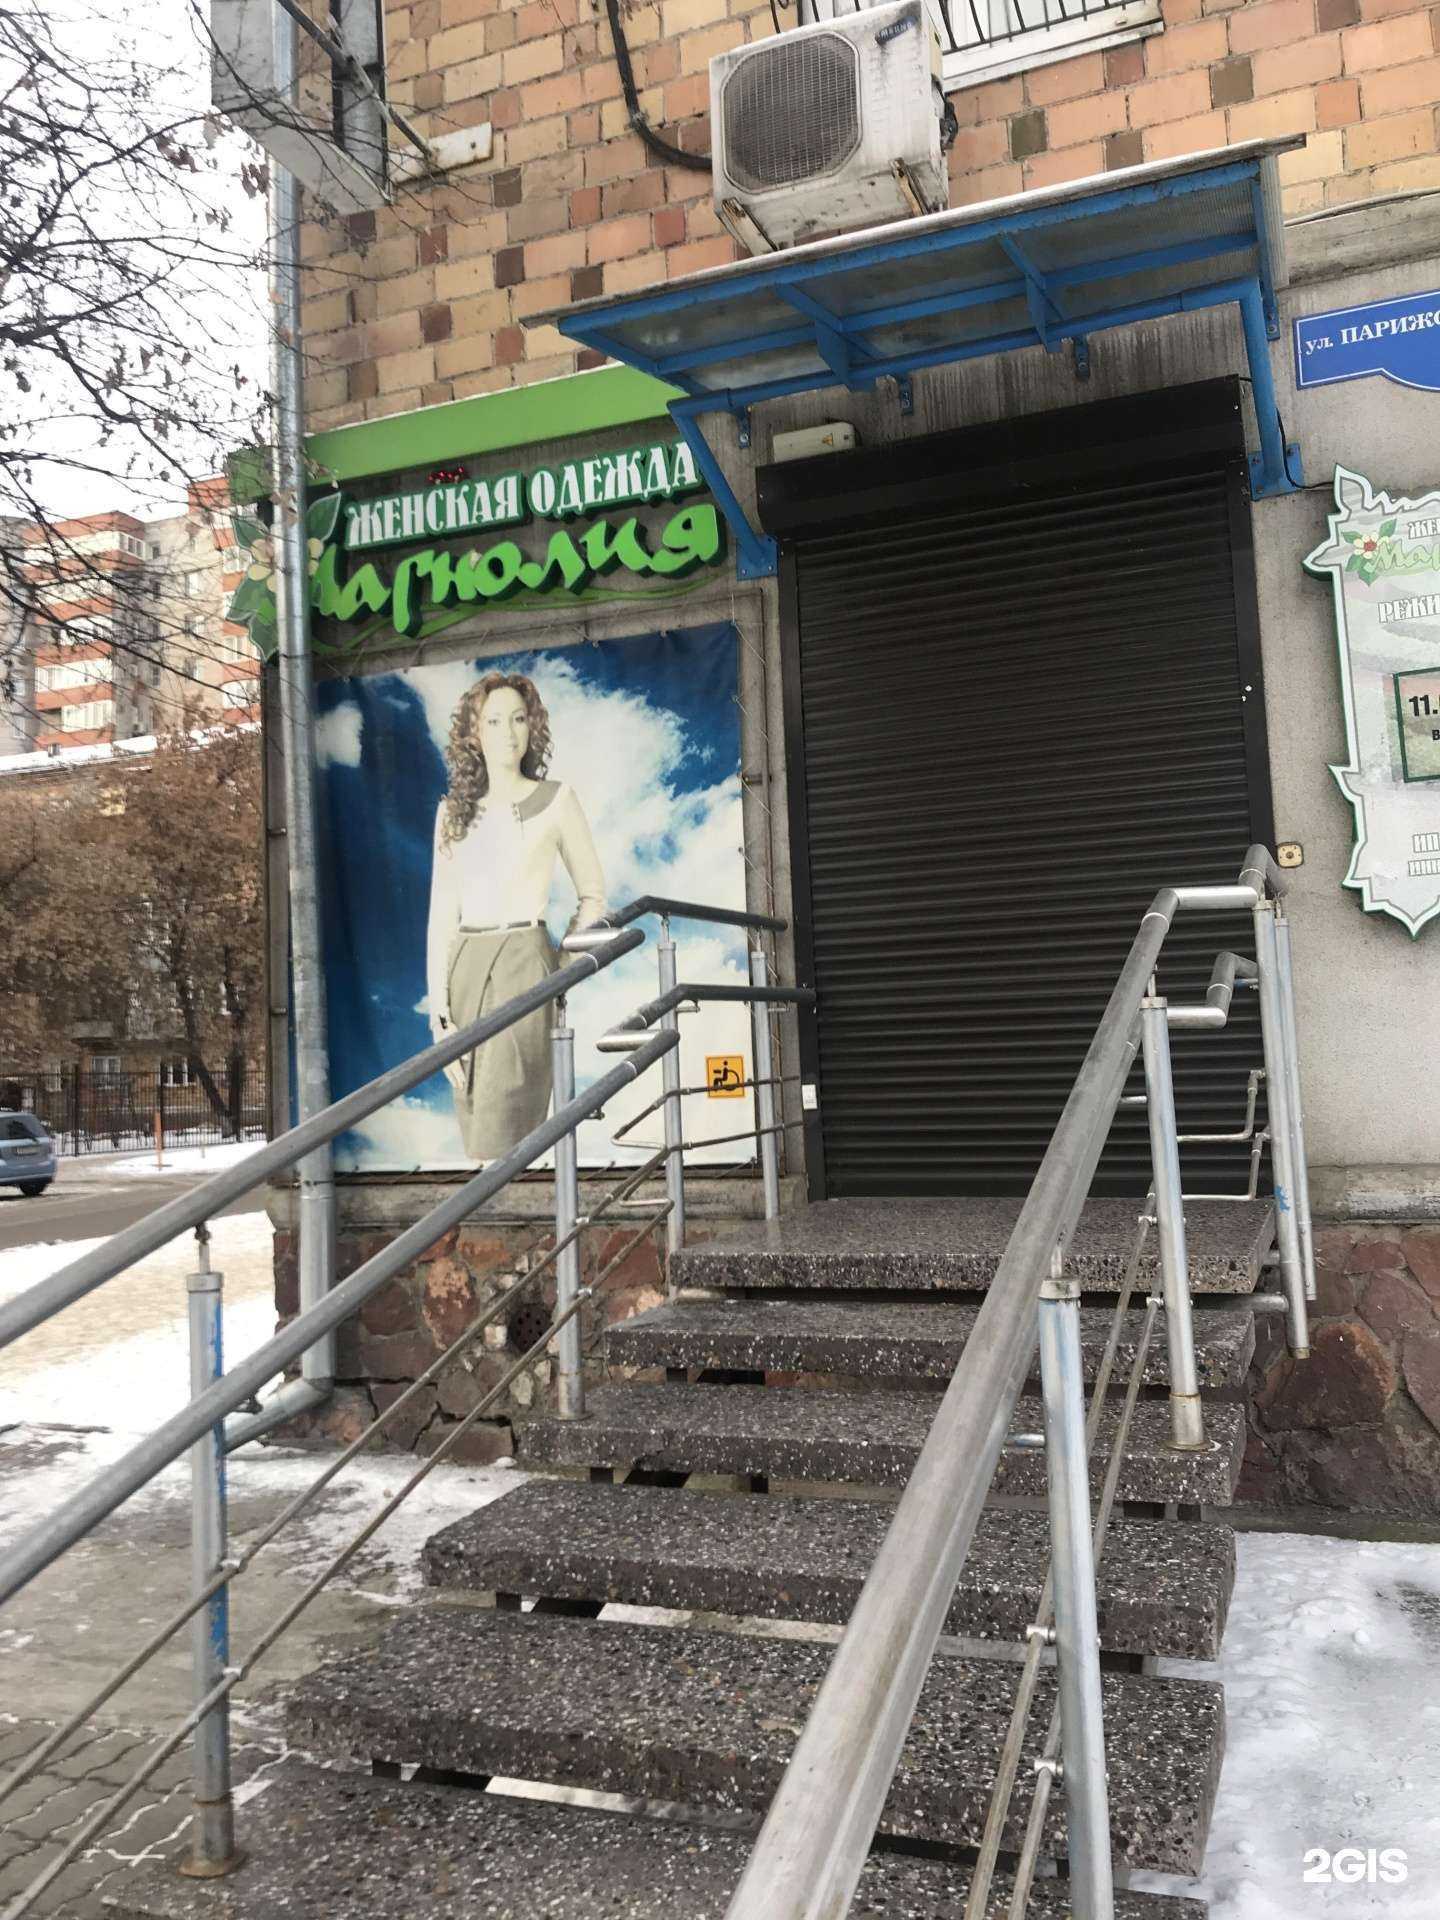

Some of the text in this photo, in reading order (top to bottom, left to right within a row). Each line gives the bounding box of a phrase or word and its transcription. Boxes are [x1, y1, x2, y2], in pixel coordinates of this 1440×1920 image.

[1305, 337, 1334, 356] ул.
[346, 441, 699, 547] ЖЕНСКАЯ ОДЕЖДА
[1409, 694, 1440, 717] 11.
